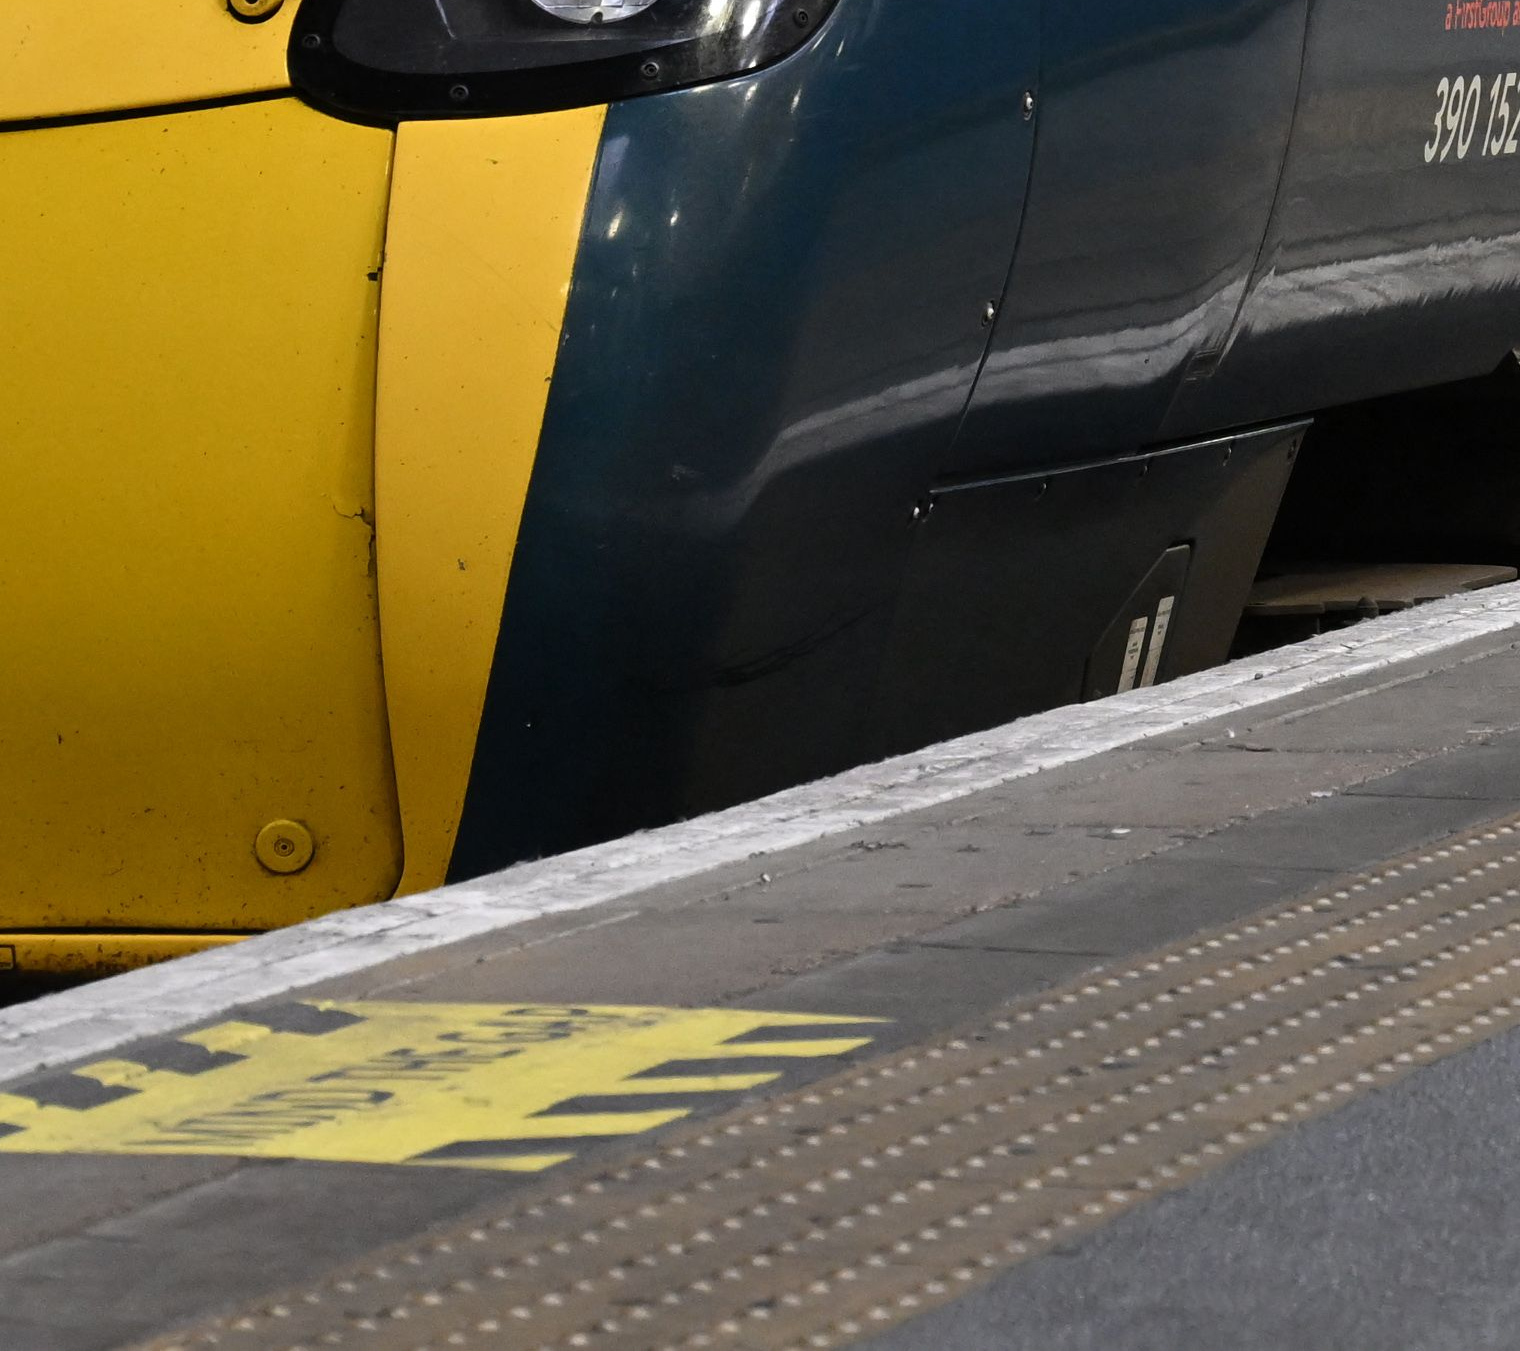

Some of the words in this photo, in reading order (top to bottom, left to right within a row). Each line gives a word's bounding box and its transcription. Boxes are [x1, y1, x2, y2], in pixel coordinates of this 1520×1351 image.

[1444, 2, 1453, 31] a
[1423, 76, 1481, 164] 390
[122, 1088, 395, 1147] MIND
[307, 1046, 525, 1083] THE
